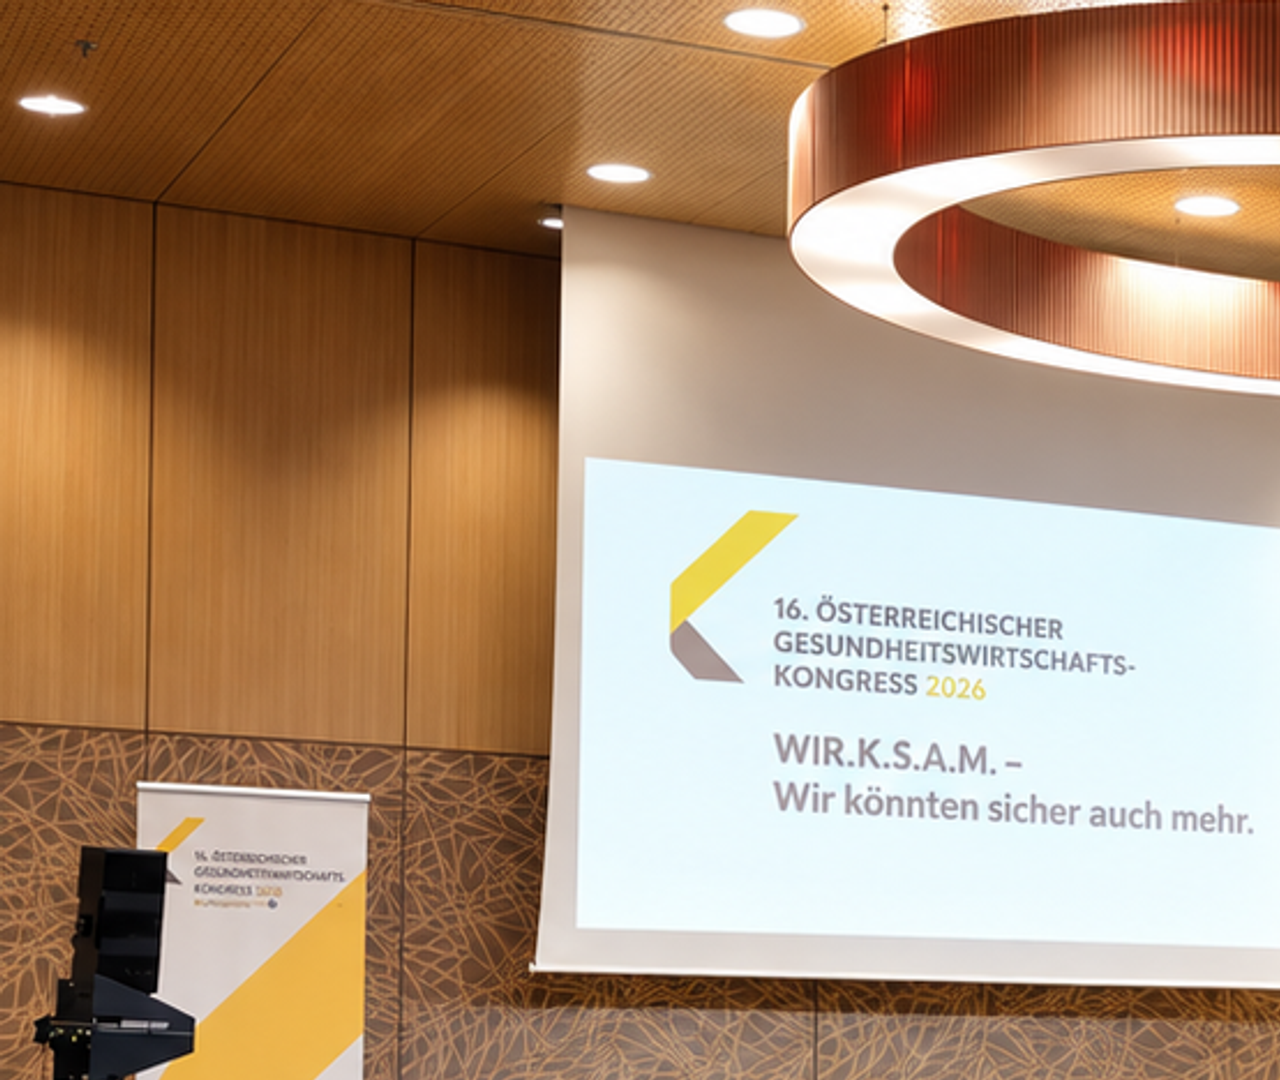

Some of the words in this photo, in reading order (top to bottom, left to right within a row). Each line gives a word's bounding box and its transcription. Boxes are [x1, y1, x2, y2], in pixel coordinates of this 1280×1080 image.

[774, 597, 809, 621] 16.
[815, 594, 1063, 641] ÖSTERREICHISCHER
[773, 630, 1136, 676] GESUNDHEITSWIRTSCHAFTS-
[774, 663, 918, 696] KONGRESS
[926, 675, 987, 701] 2026
[773, 732, 997, 776] WIR.K.S.A.M.
[772, 780, 837, 814] Wir
[844, 783, 979, 821] könnten
[987, 792, 1082, 826] sicher
[1089, 800, 1162, 830] auch
[1172, 804, 1254, 835] mehr.
